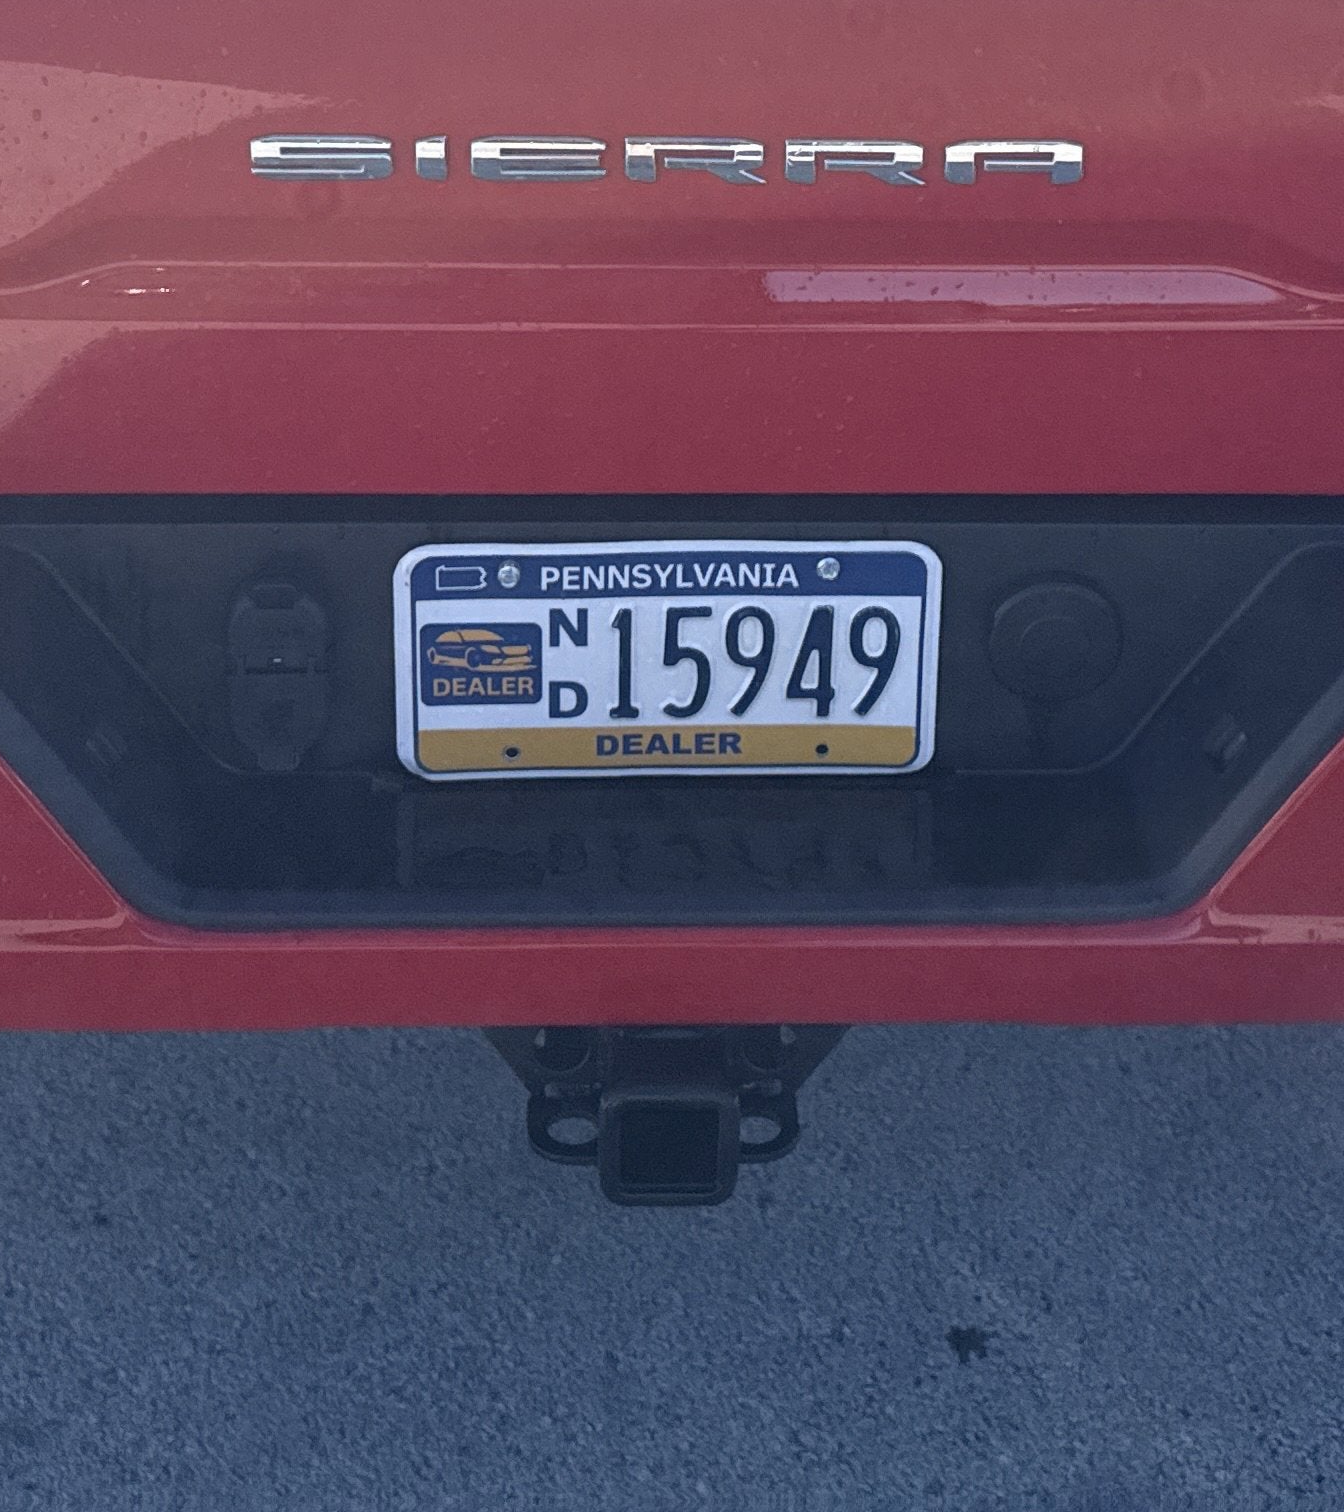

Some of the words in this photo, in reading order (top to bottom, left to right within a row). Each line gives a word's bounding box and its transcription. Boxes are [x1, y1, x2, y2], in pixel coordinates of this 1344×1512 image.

[249, 134, 1085, 186] SIERRA
[540, 563, 799, 591] PENNSYLVANIA
[608, 604, 902, 719] 15949
[432, 677, 535, 698] DEALER
[595, 733, 743, 757] DEALER
